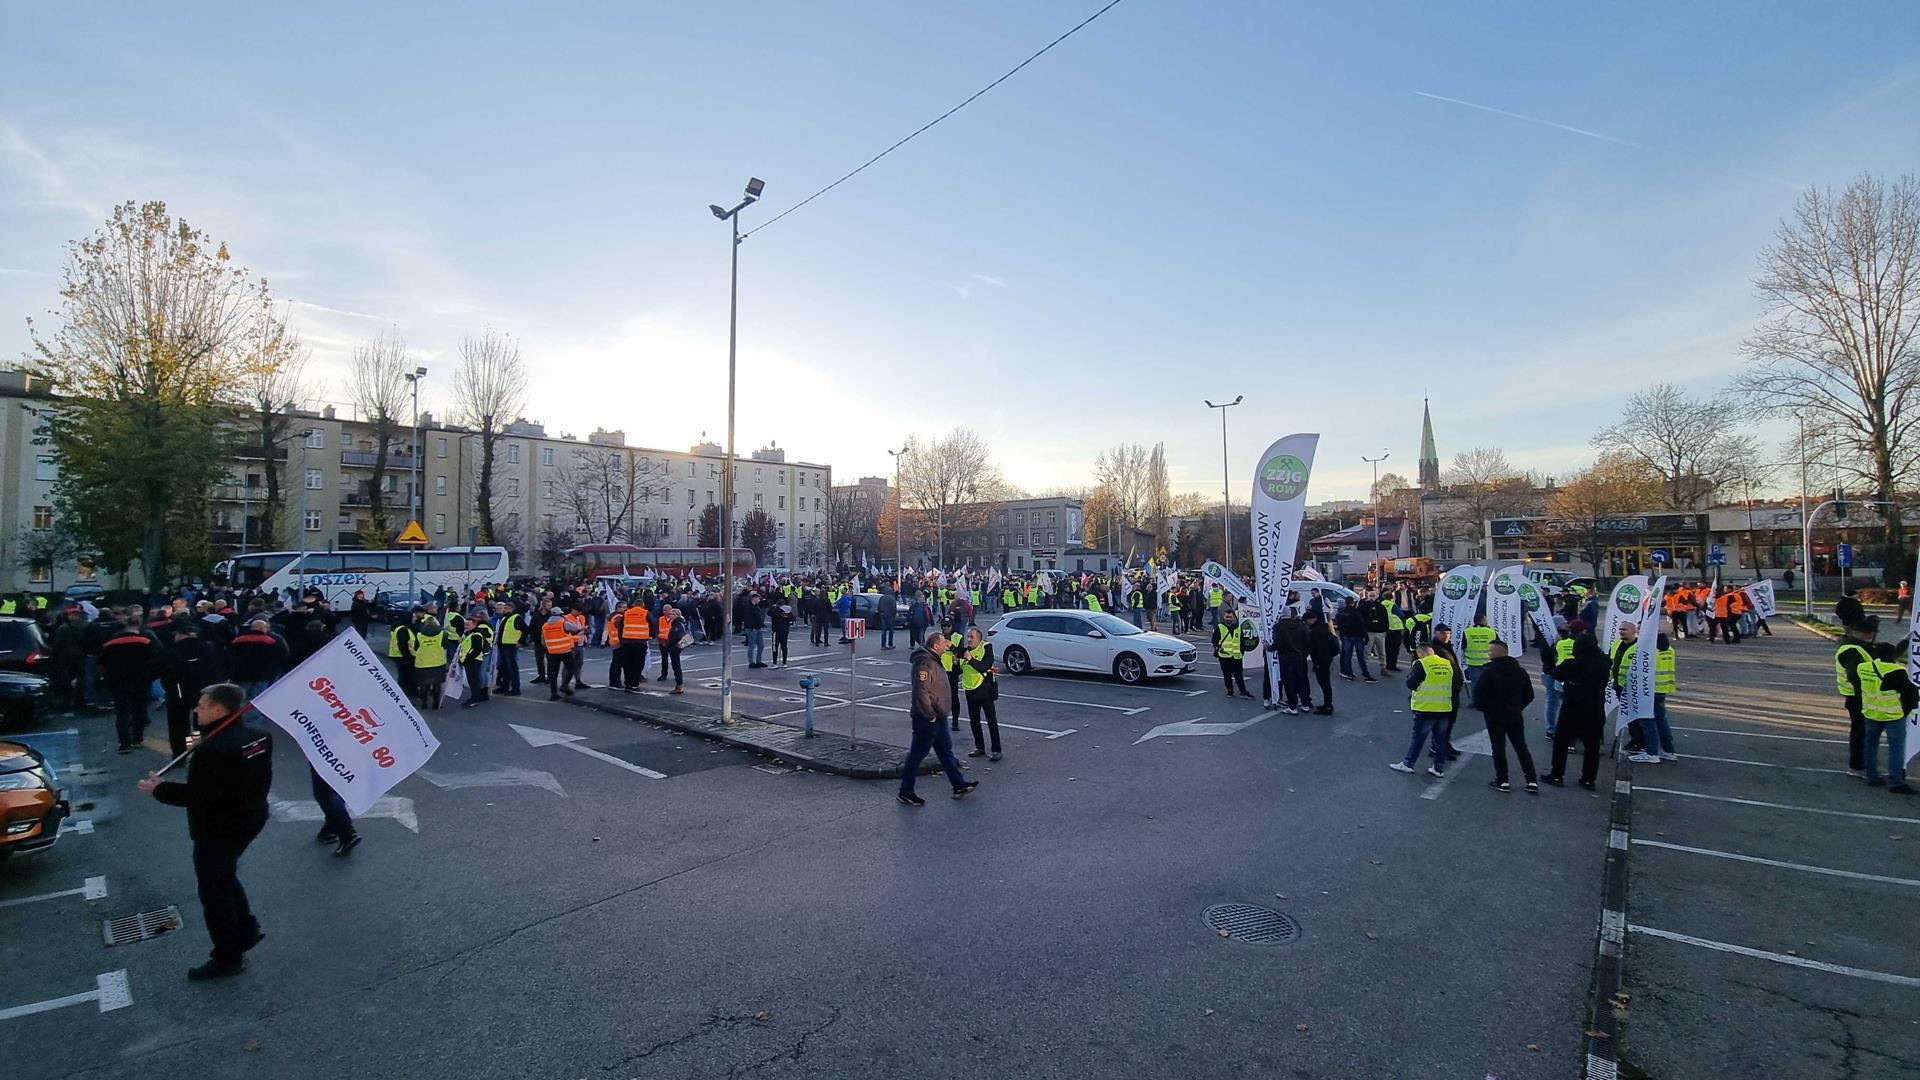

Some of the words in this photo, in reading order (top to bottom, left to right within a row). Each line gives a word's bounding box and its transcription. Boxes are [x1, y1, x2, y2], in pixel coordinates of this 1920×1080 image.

[1266, 468, 1302, 485] ZZJG
[1268, 483, 1297, 494] ROW
[1258, 511, 1271, 604] ZAWODOWY
[1279, 560, 1293, 598] ROW
[1618, 592, 1639, 604] ZZJG
[343, 638, 369, 667] Wolny
[367, 665, 401, 704] Związek
[1641, 650, 1650, 674] ROW
[308, 676, 379, 745] Sierpień
[372, 746, 396, 769] 80
[289, 708, 358, 784] KONFEDERACJA
